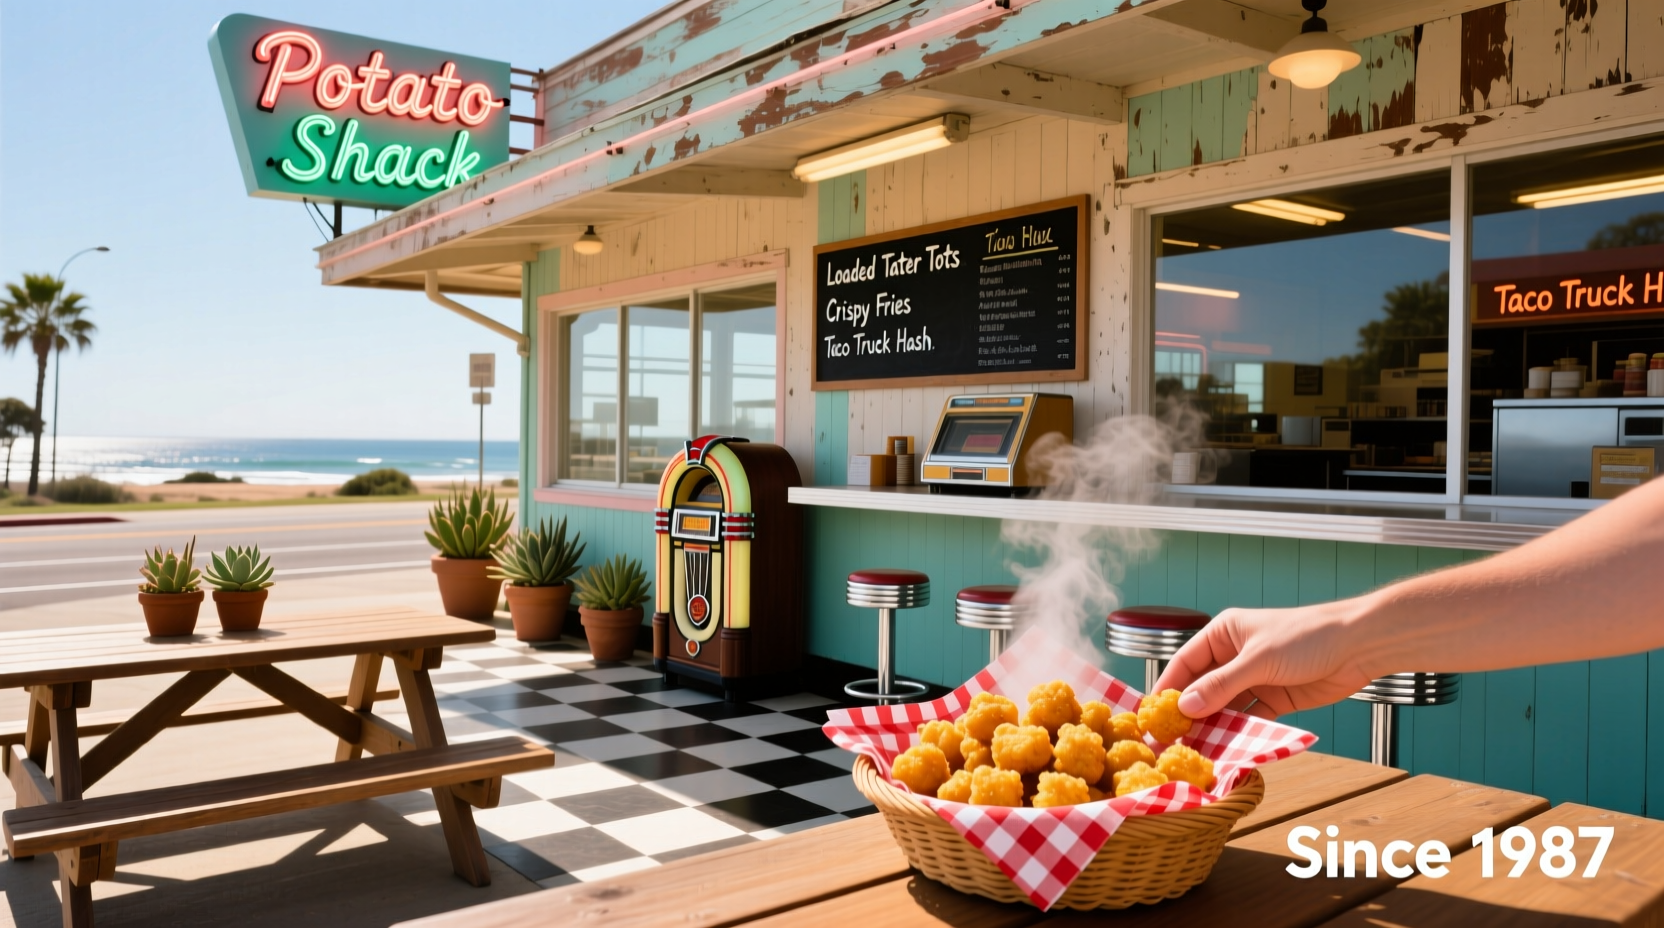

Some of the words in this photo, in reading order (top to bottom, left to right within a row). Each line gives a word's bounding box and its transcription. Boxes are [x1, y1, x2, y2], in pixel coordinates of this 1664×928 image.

[254, 30, 506, 126] Potato
[281, 113, 481, 189] Shack
[827, 255, 876, 286] Loaded
[881, 252, 922, 278] Tater
[925, 243, 960, 272] Tots
[826, 298, 871, 328] Crispy
[876, 292, 912, 317] Fries
[1494, 284, 1553, 314] Taco
[1559, 274, 1635, 310] Truck
[824, 335, 850, 358] Taco
[853, 330, 891, 355] Truck
